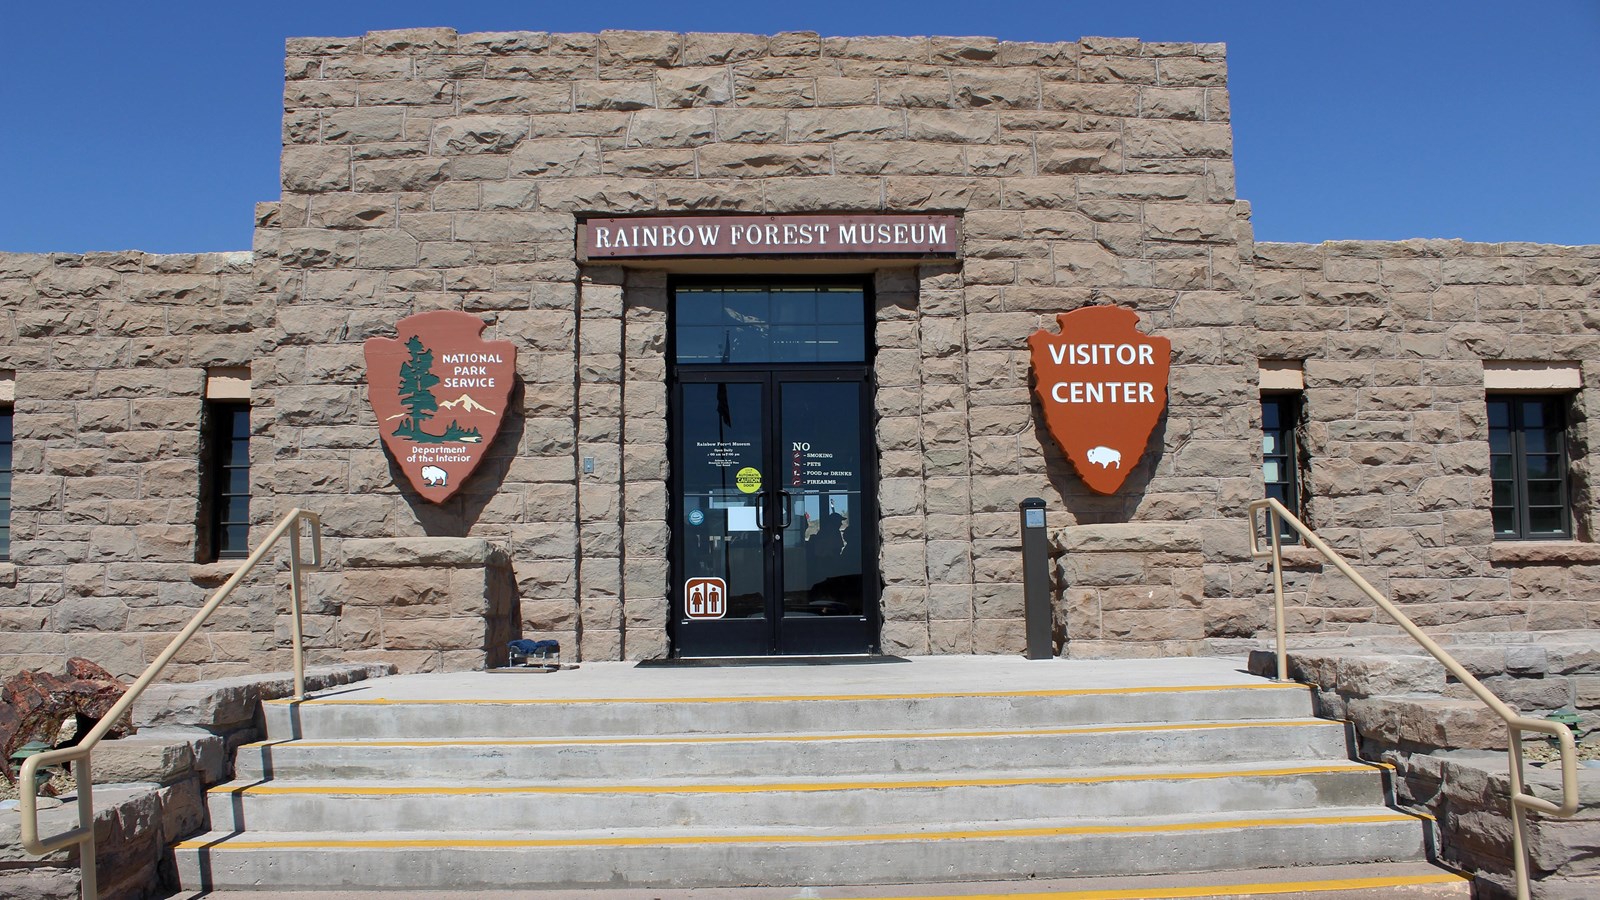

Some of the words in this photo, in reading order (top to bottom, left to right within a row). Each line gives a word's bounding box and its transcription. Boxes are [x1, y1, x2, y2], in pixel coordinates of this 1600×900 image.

[595, 225, 720, 247] RAINBOW
[730, 223, 830, 245] FOREST
[838, 223, 947, 244] MUSEUM
[442, 353, 503, 363] NATIONAL
[1048, 343, 1155, 365] VISITOR
[454, 366, 487, 375] PARK
[443, 377, 495, 387] SERVICE
[1051, 382, 1155, 403] CENTER
[412, 446, 466, 455] Department
[792, 442, 811, 451] NO
[406, 454, 416, 462] of
[436, 454, 471, 462] Interior
